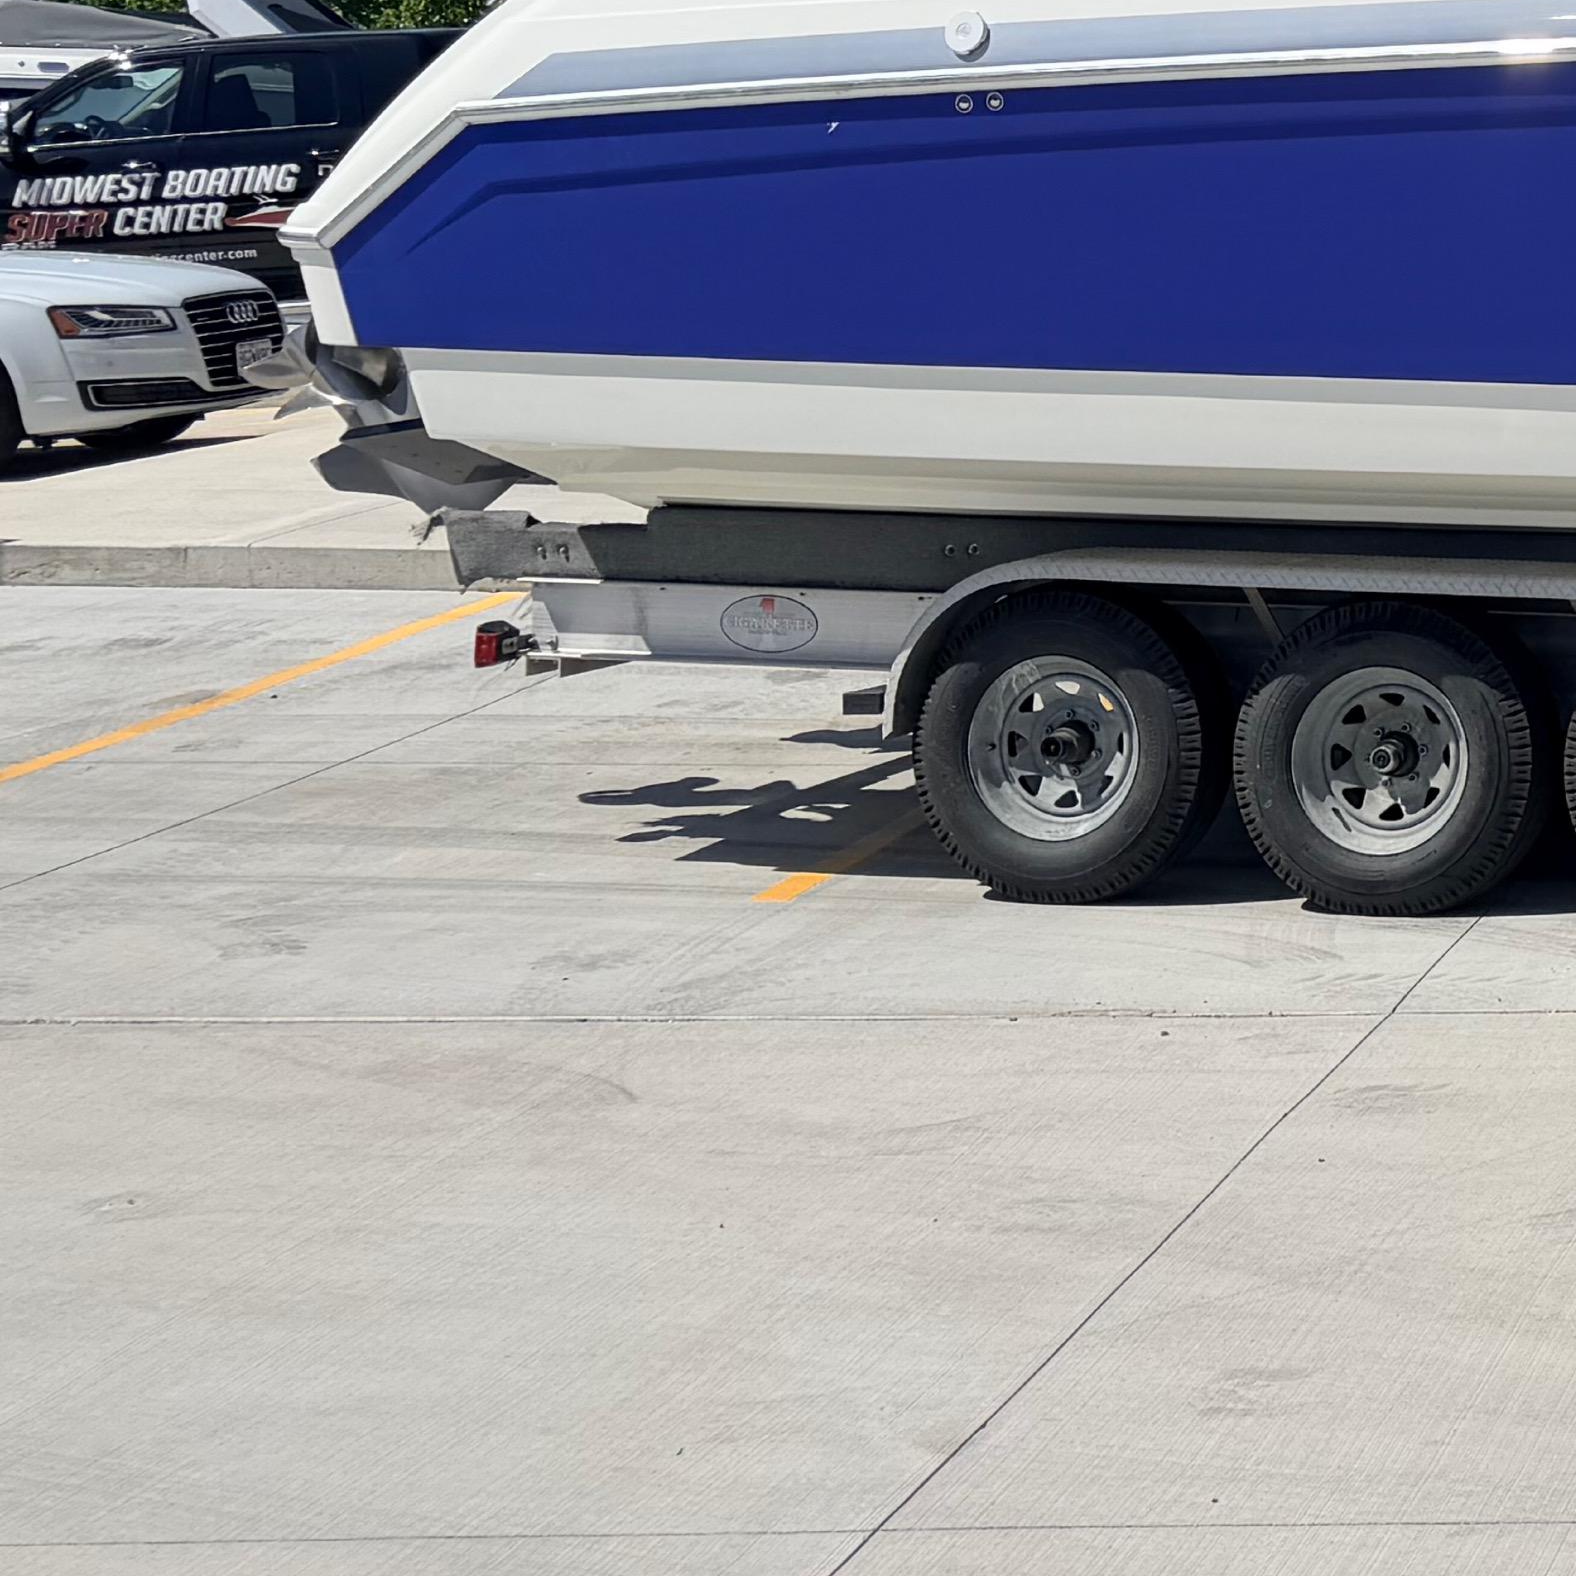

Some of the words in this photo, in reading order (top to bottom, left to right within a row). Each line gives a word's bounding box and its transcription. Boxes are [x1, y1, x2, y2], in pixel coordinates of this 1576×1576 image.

[11, 171, 161, 208] MIDWEST
[161, 163, 300, 200] BOATING
[3, 209, 109, 243] SUPER
[112, 201, 229, 237] CENTER
